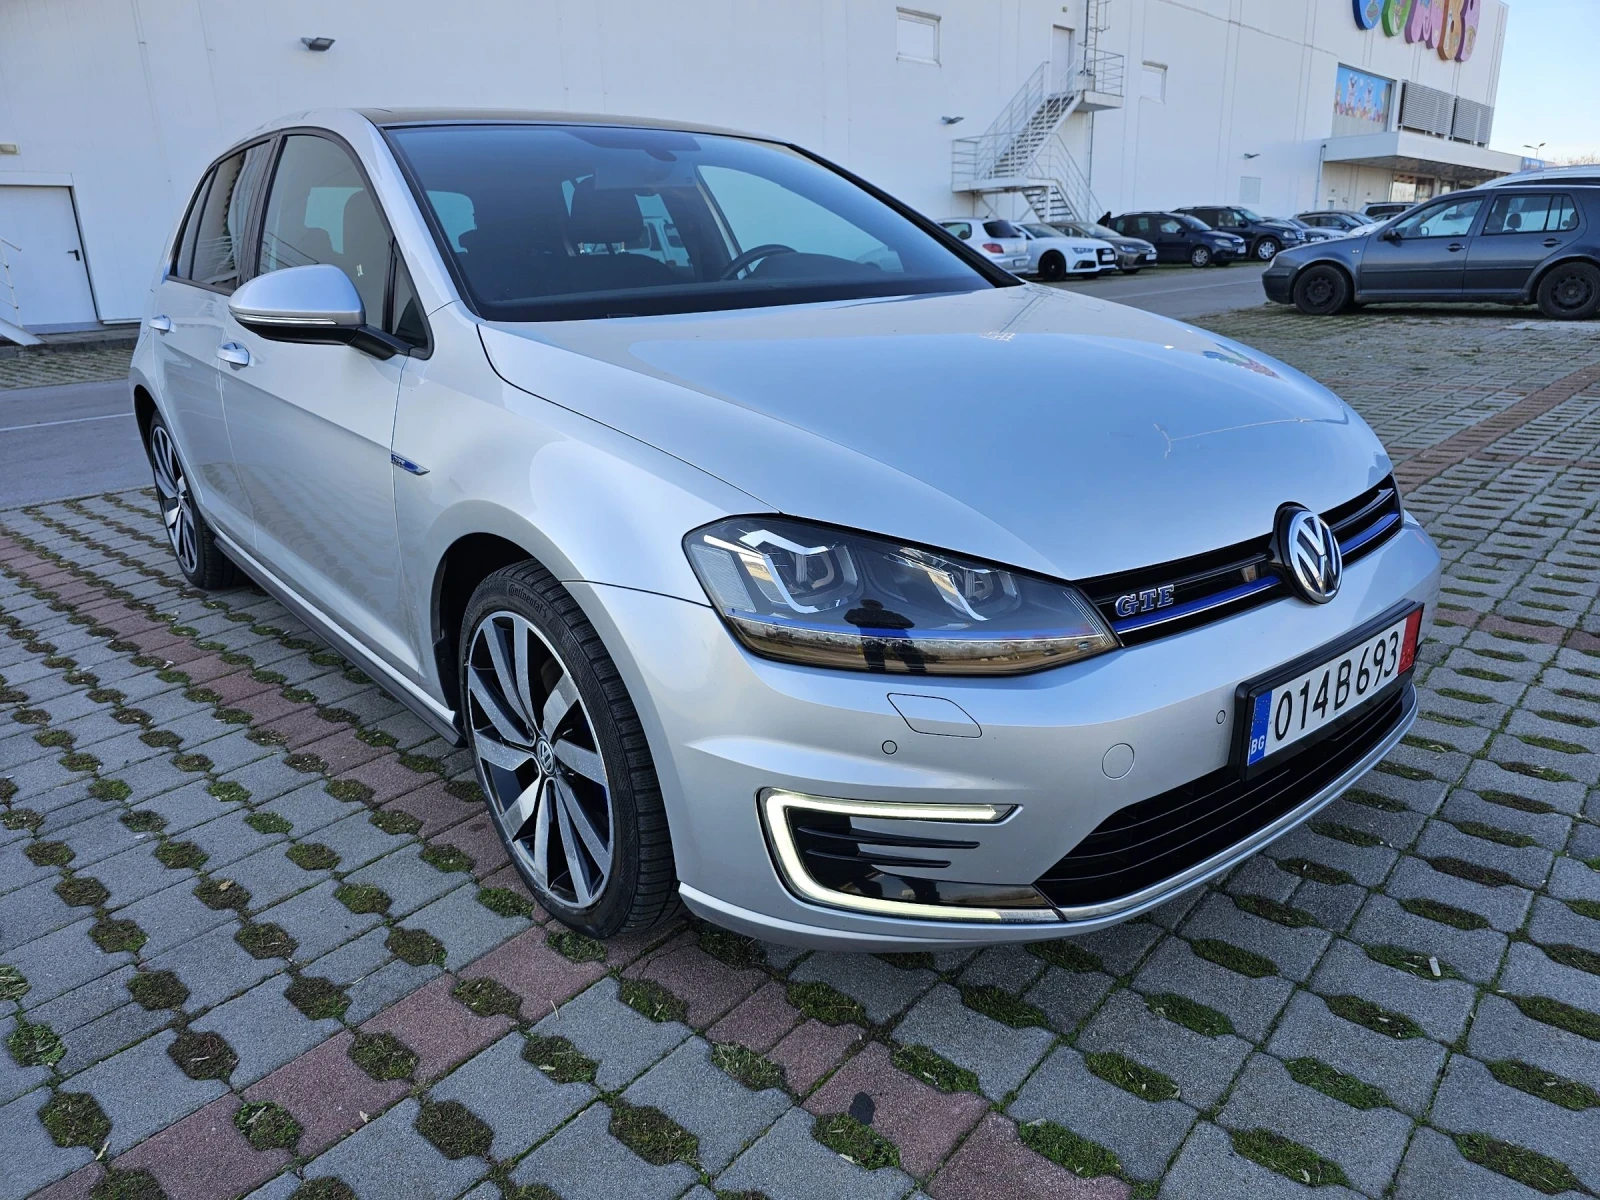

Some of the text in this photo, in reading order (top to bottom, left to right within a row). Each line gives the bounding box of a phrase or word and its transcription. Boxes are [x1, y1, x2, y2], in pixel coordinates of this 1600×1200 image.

[508, 583, 543, 613] Continental
[1115, 584, 1175, 617] GTE
[1274, 631, 1399, 742] 014B693
[1250, 735, 1266, 755] BG
